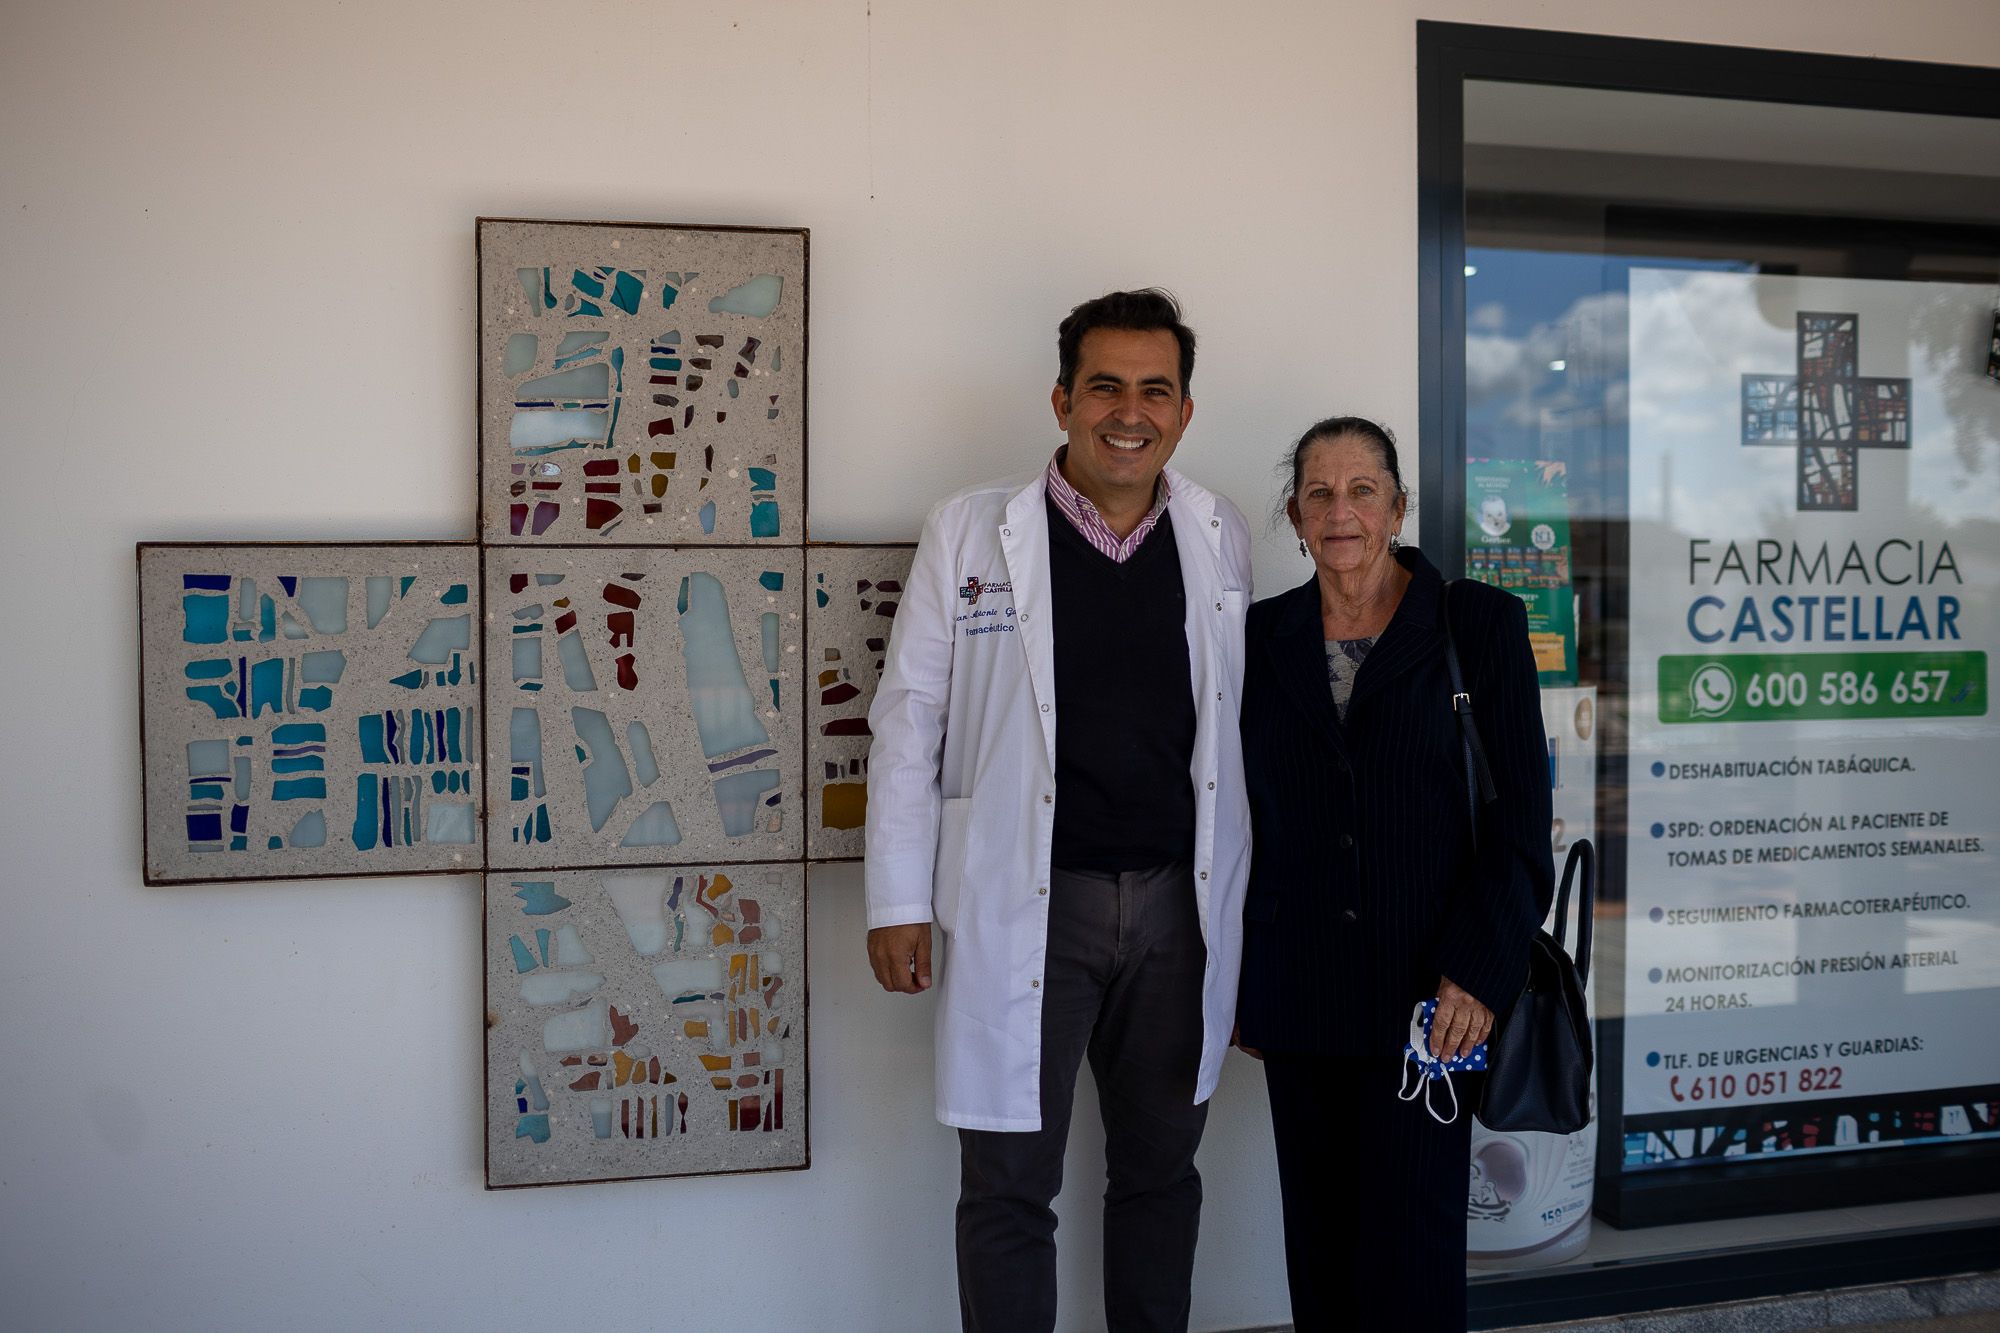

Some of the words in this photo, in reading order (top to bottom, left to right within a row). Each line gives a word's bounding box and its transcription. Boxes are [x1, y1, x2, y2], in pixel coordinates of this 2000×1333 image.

[1688, 539, 1963, 586] FARMACIA
[1687, 595, 1962, 644] CASTELLAR
[1746, 672, 1807, 707] 600
[1819, 671, 1878, 705] 586
[1890, 670, 1950, 703] 657
[1669, 755, 1813, 780] DESHABITUACIÓN
[1817, 754, 1916, 775] TABÁQUICA.
[1668, 821, 1704, 839] SPD:
[1709, 812, 1823, 837] ORDENACIÓN
[1827, 816, 1847, 831] AL
[1851, 811, 1925, 830] PACIENTE
[1929, 811, 1949, 827] DE
[1668, 849, 1727, 868] TOMAS
[1732, 847, 1753, 865] DE
[1757, 842, 1887, 864] MEDICAMENTOS
[1891, 837, 1984, 857] SEMANALES.
[1667, 904, 1778, 926] SEGUIMIENTO
[1783, 892, 1971, 919] FARMACOTERAPÉUTICO.
[1665, 956, 1815, 984] MONITORIZACIÓN
[1820, 951, 1886, 974] PRESIÓN
[1890, 950, 1959, 969] ARTERIAL
[1665, 997, 1685, 1013] 24
[1690, 992, 1753, 1011] HORAS.
[1663, 1054, 1692, 1070] TLF.
[1697, 1051, 1719, 1067] DE
[1724, 1044, 1819, 1066] URGENCIAS
[1823, 1042, 1833, 1058] Y
[1838, 1036, 1924, 1057] GUARDIAS:
[1690, 1075, 1736, 1101] 610
[1746, 1071, 1787, 1097] 051
[1798, 1066, 1842, 1092] 822
